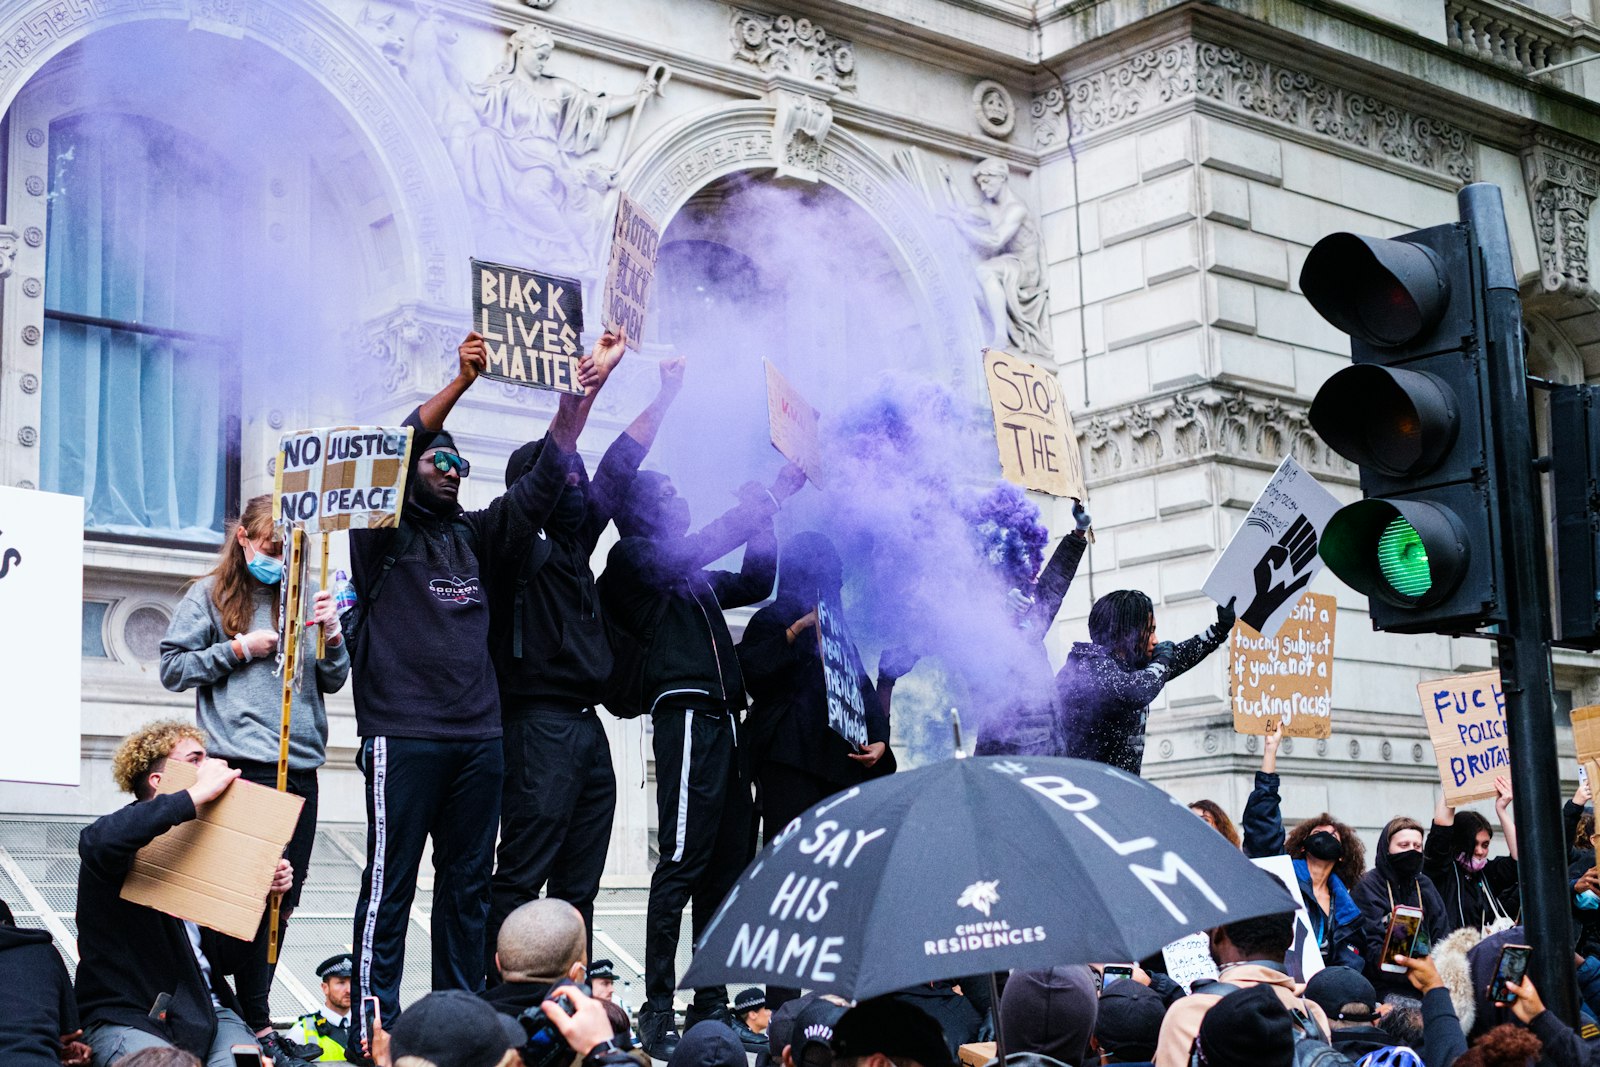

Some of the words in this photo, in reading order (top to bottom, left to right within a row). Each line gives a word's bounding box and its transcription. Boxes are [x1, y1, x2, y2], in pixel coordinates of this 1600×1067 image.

[482, 308, 577, 356] LIVES
[483, 341, 585, 393] MATTER
[992, 361, 1058, 419] STOP
[284, 436, 321, 470] NO
[327, 433, 407, 460] JUSTICE
[1002, 422, 1059, 477] THE
[280, 491, 318, 523] NO
[327, 487, 396, 512] PEACE
[1320, 609, 1329, 623] a
[1283, 628, 1331, 662] subject
[1234, 652, 1246, 682] if
[1289, 654, 1315, 677] not
[1317, 661, 1327, 678] a
[1234, 684, 1292, 726] fucking
[1292, 684, 1331, 718] racist
[799, 820, 887, 869] SAY
[769, 871, 839, 923] HIS
[924, 925, 1047, 955] RESIDENCES
[955, 919, 1010, 936] CHEVAL
[725, 922, 845, 982] NAME
